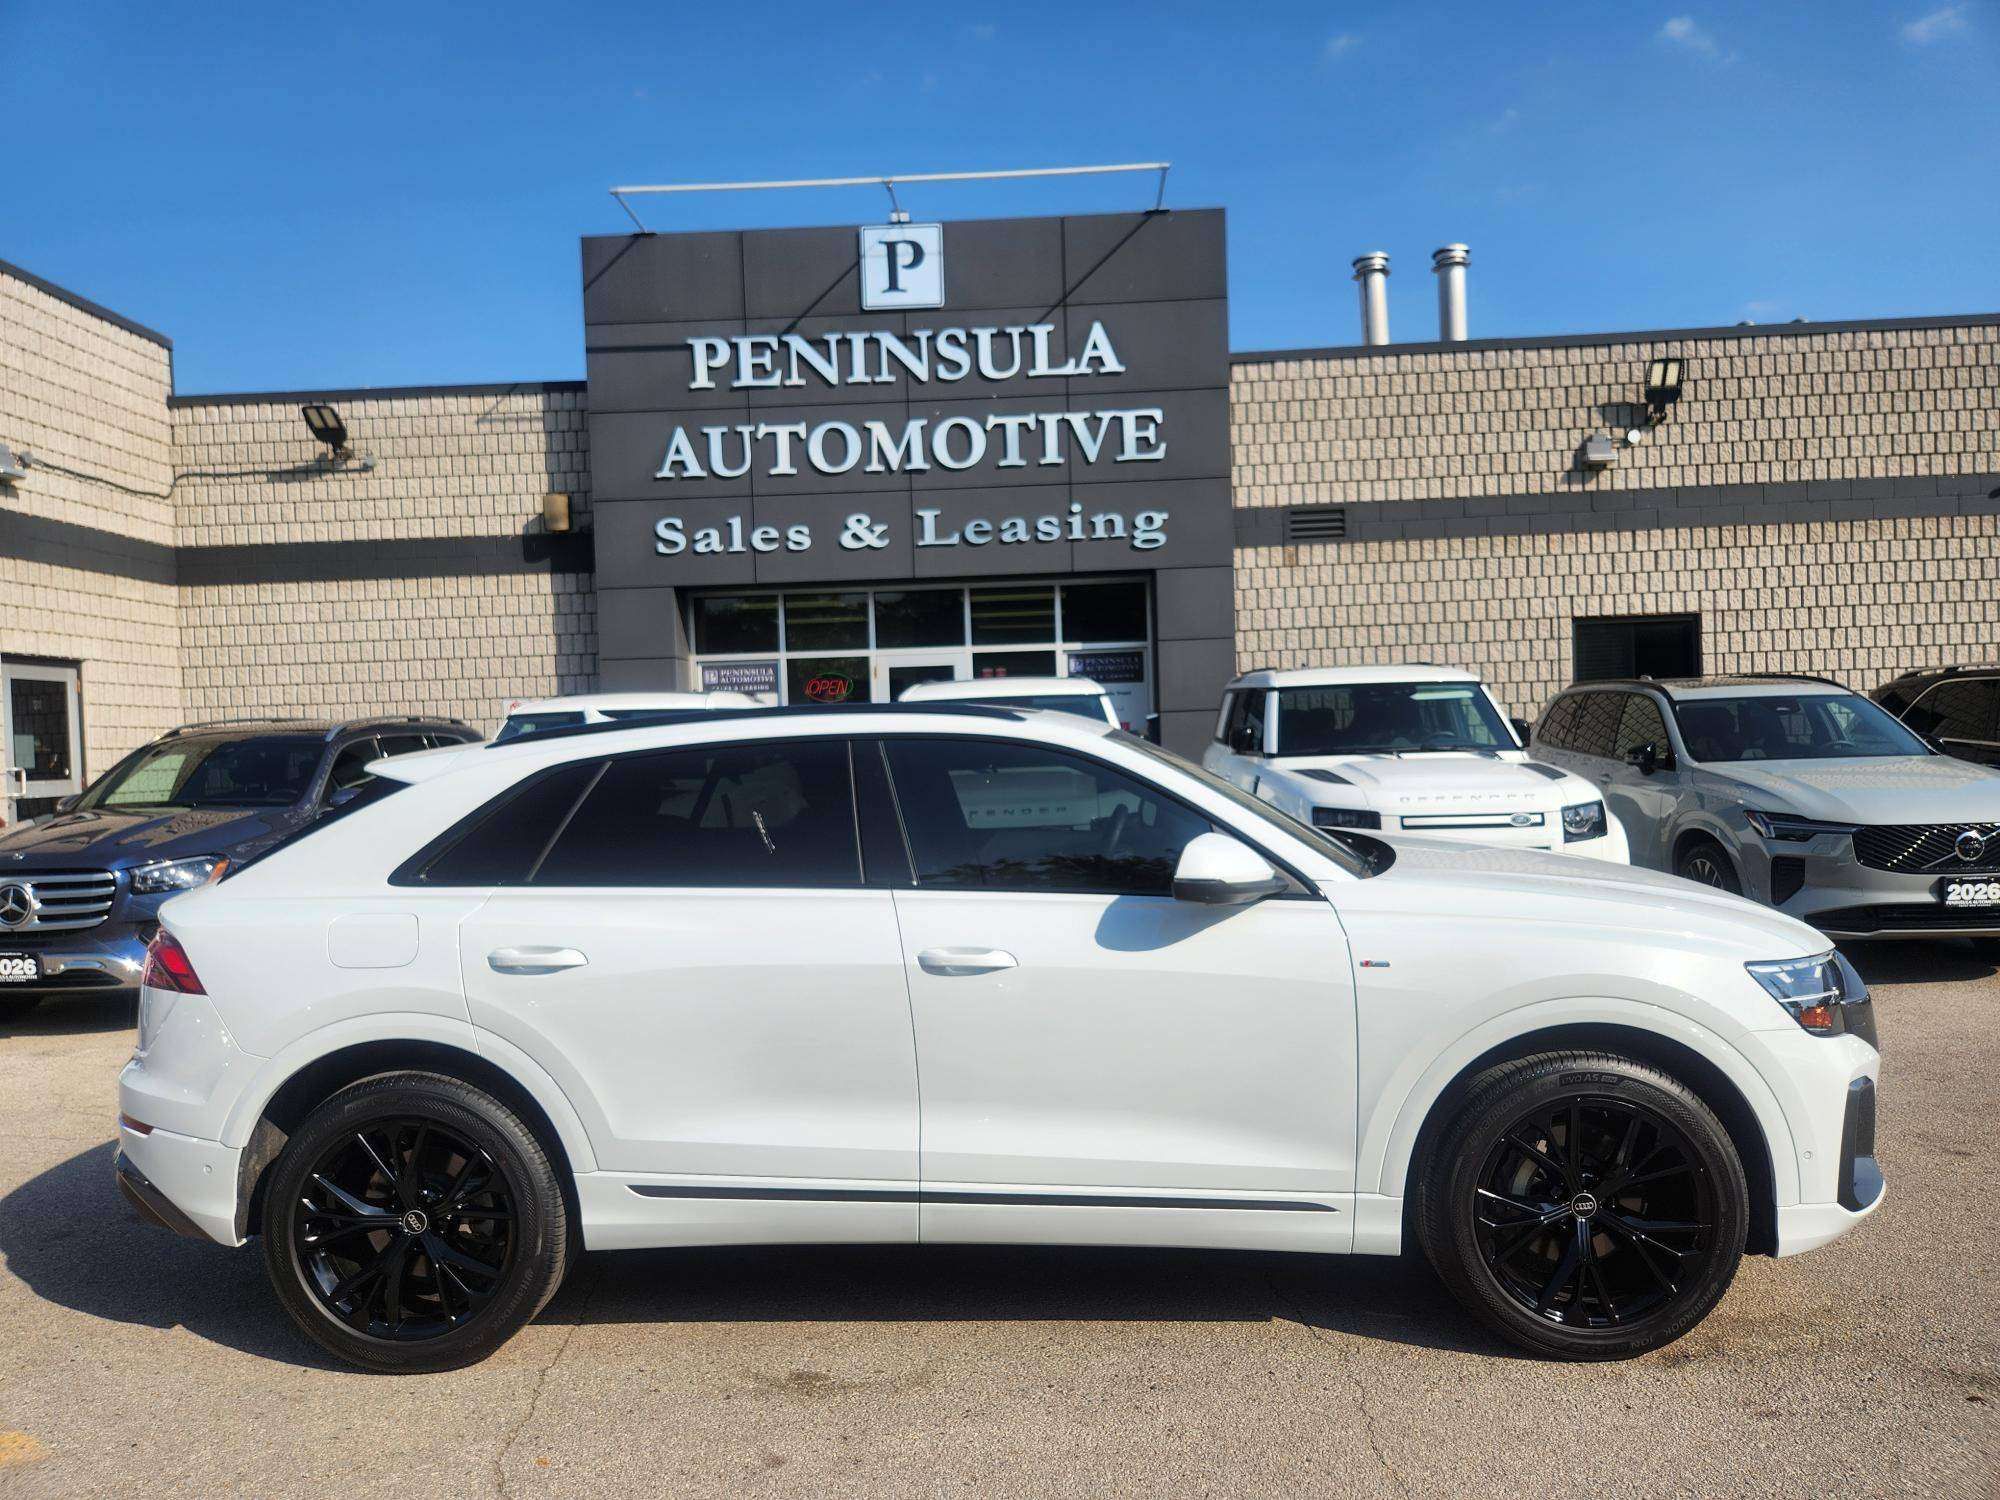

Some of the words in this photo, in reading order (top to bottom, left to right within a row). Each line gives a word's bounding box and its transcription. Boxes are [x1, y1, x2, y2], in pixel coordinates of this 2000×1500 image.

[881, 239, 925, 294] P
[686, 321, 1126, 391] PENINSULA
[655, 408, 1167, 479] AUTOMOTIVE
[655, 516, 812, 556] Sales
[839, 512, 890, 550] &
[915, 502, 1170, 549] Leasing
[721, 667, 775, 677] PENINSULA
[721, 675, 776, 684] AUTOMOTIVE
[805, 679, 849, 695] OPEN
[1947, 883, 2000, 900] 2026
